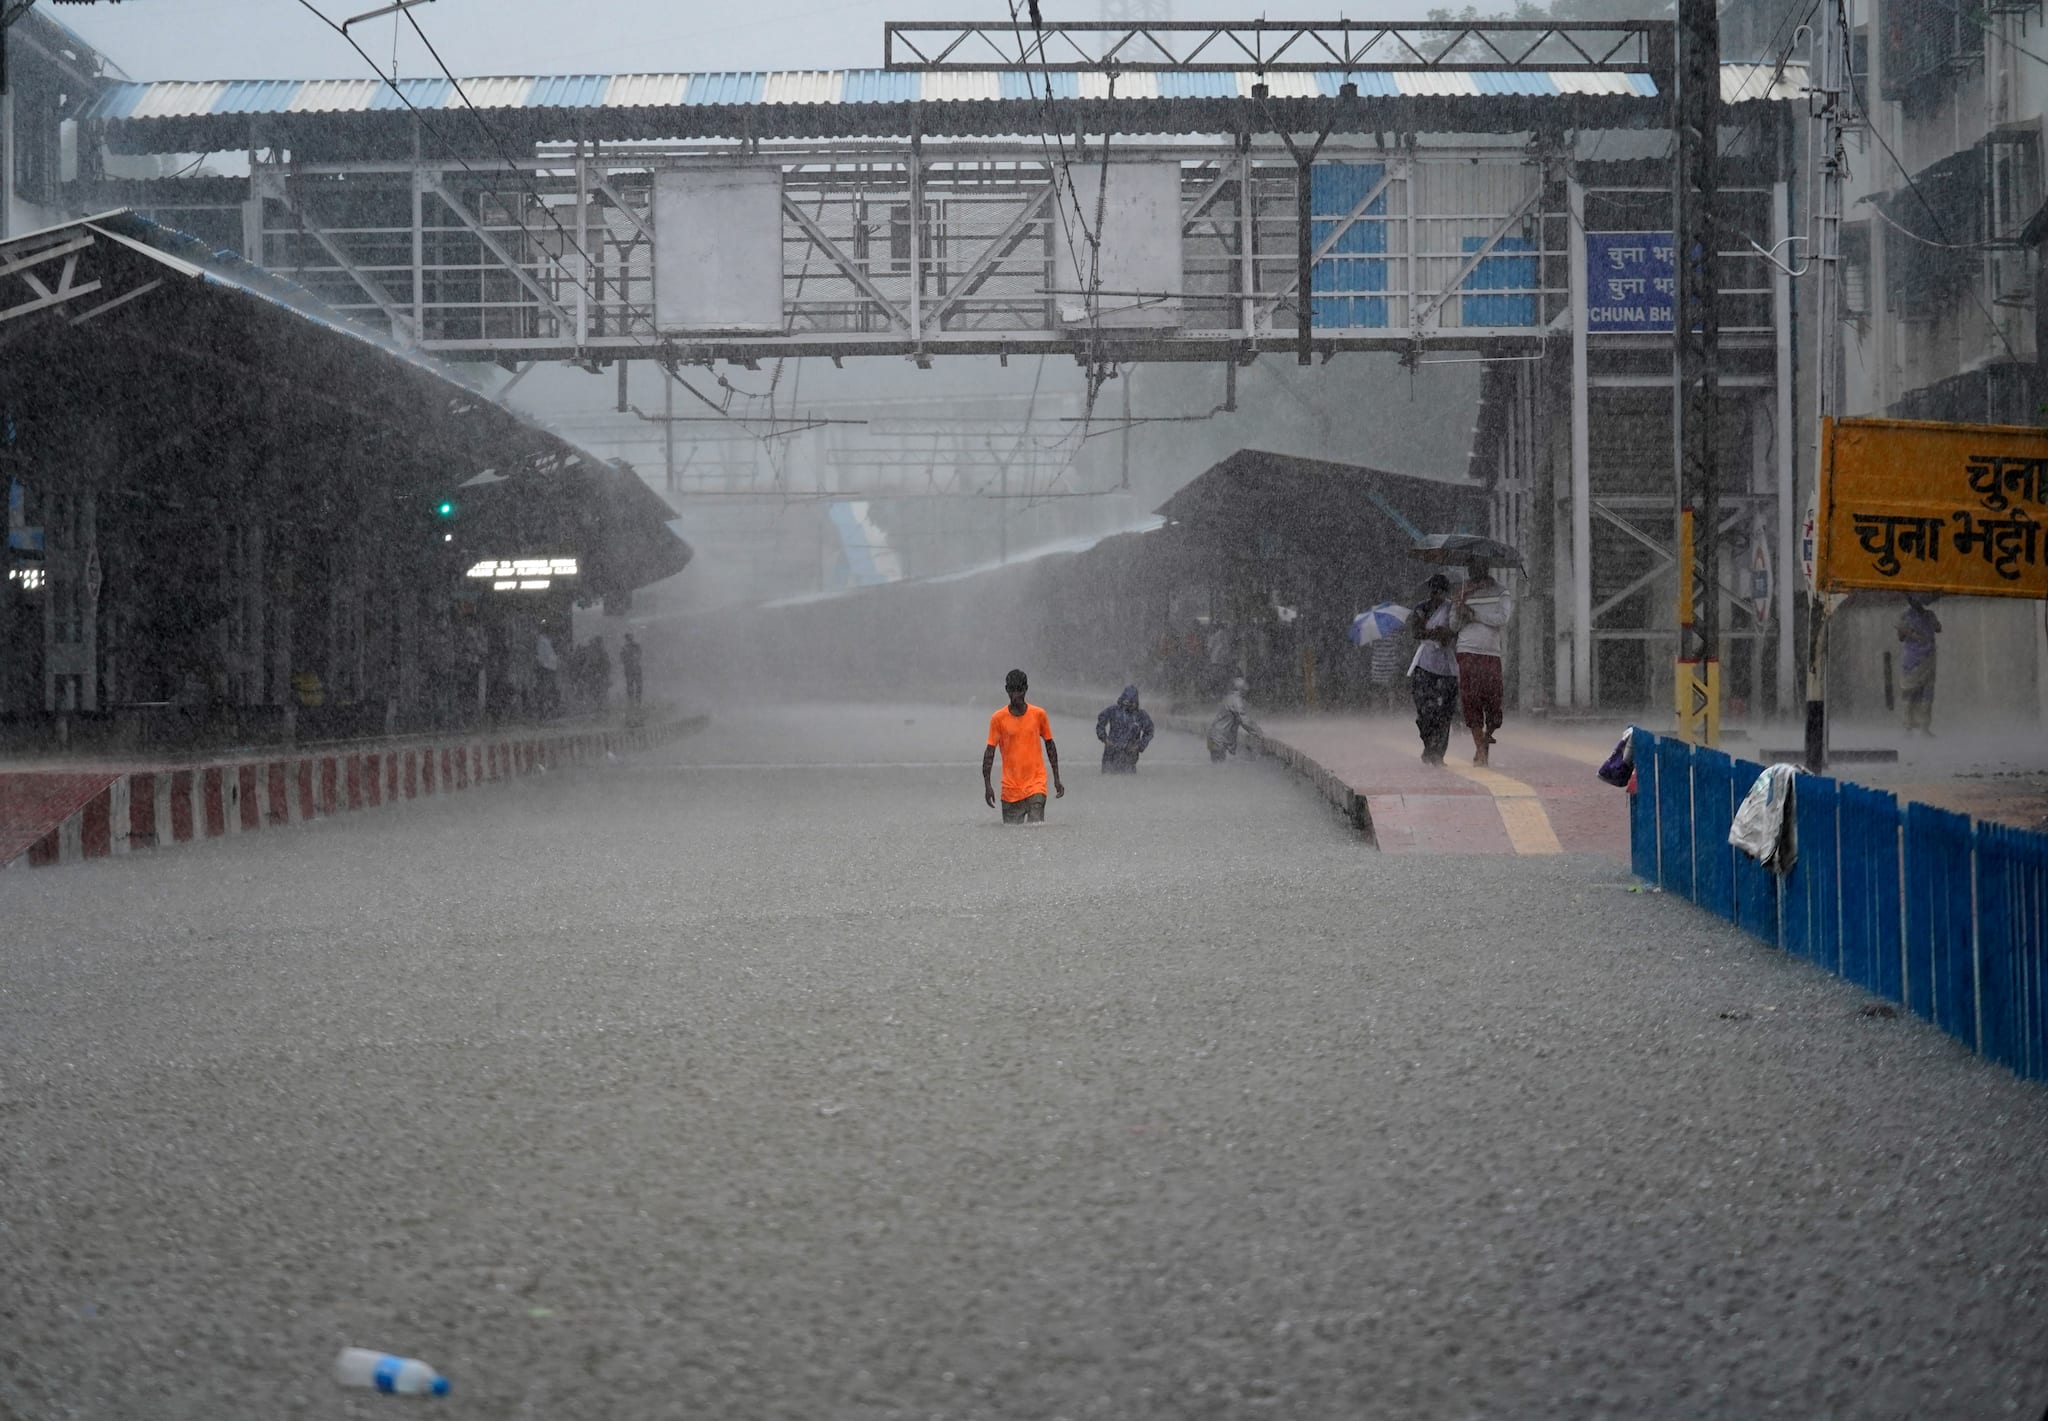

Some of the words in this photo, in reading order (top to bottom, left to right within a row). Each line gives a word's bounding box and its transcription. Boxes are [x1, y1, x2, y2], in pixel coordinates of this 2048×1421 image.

[1608, 247, 1646, 270] चुना
[1608, 278, 1646, 301] चुना
[1590, 306, 1646, 322] CHUNA
[1649, 306, 1674, 322] BH
[1852, 513, 1945, 577] चुना
[1952, 507, 2041, 581] भट्टी
